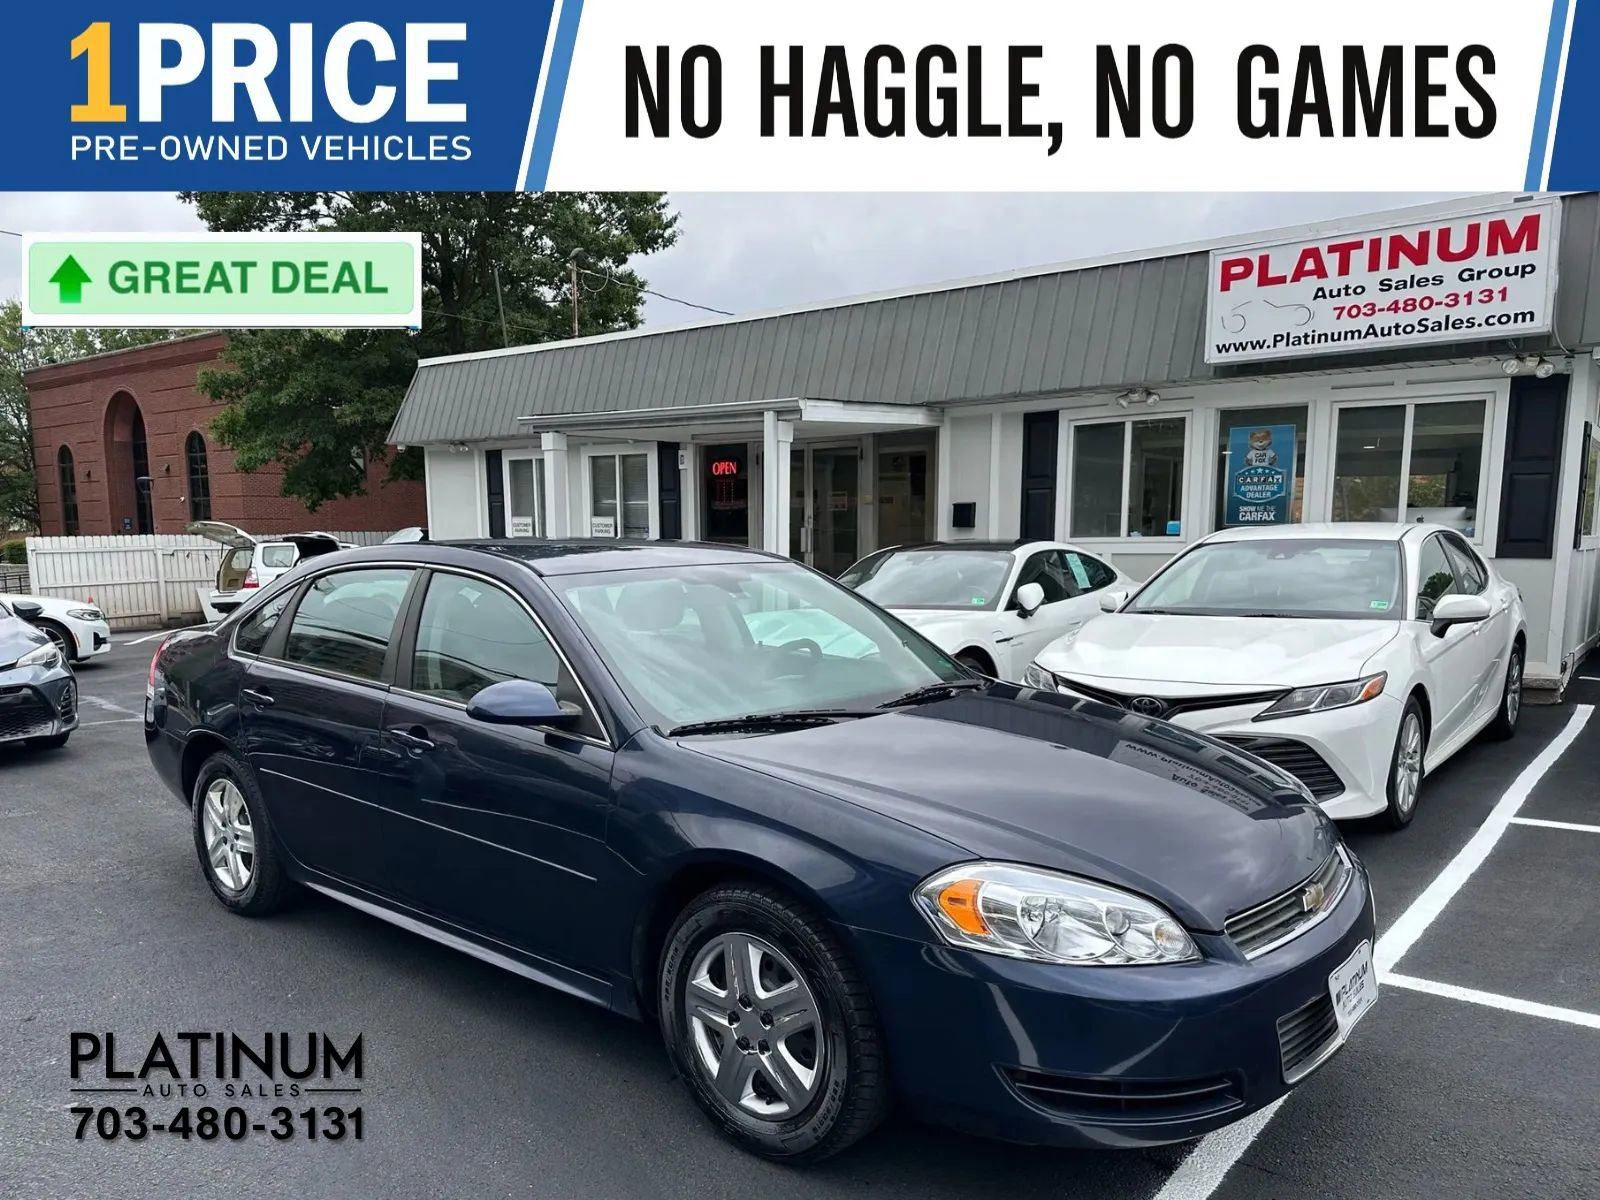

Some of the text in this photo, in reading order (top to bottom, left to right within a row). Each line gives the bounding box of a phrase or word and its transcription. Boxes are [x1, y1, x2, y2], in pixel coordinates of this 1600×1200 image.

[1219, 213, 1541, 292] PLATINUM
[1312, 262, 1536, 301] Auto Sales Group
[1333, 287, 1508, 321] 703-480-3131
[1215, 310, 1536, 354] www.PlatinumAutoSales.com
[712, 461, 738, 476] OPEN
[1238, 475, 1282, 484] CARFAX
[1240, 484, 1278, 492] ADVANTAGE
[1246, 491, 1271, 499] DEALER
[1239, 511, 1275, 521] CARFAX
